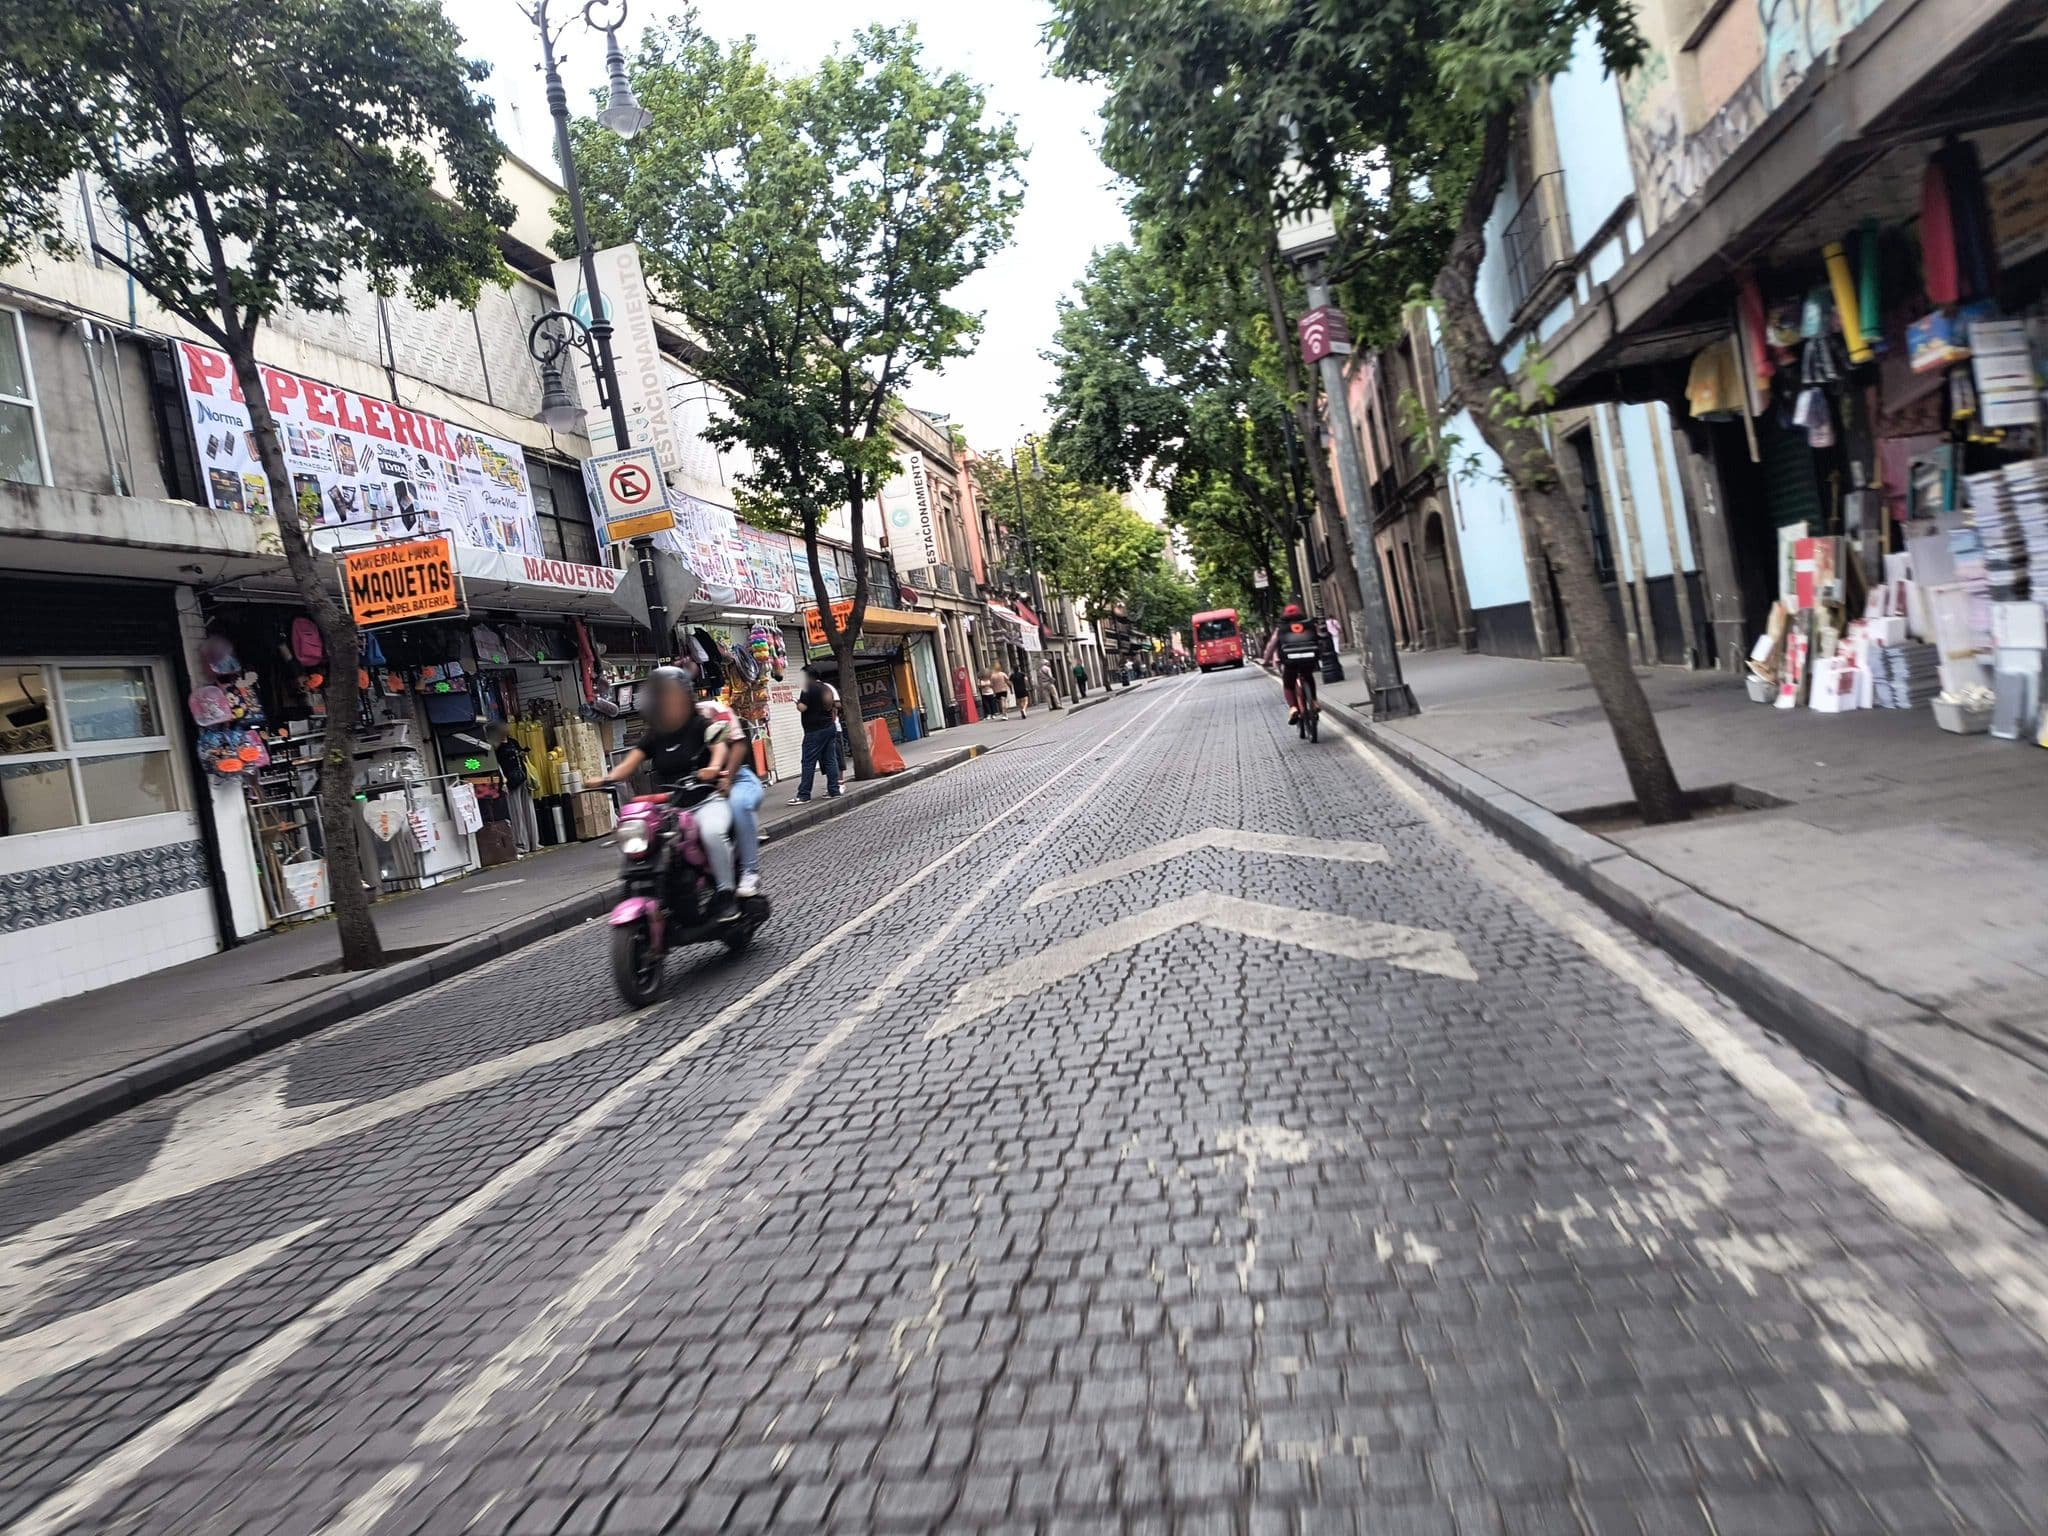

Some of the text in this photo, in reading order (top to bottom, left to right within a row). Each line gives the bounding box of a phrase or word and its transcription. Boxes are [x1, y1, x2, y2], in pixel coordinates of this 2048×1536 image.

[617, 253, 677, 468] ESTACIONAMIENTO
[196, 399, 244, 427] Norma
[384, 461, 409, 474] LYRA
[910, 455, 937, 565] ESTACIONAMIENTO
[350, 545, 440, 572] MATERIAL PARA
[351, 560, 450, 606] MAQUETAS
[523, 556, 614, 590] MAQUETAS
[386, 595, 450, 616] PAPEL BATERIA
[734, 587, 781, 609] DIDACTICO
